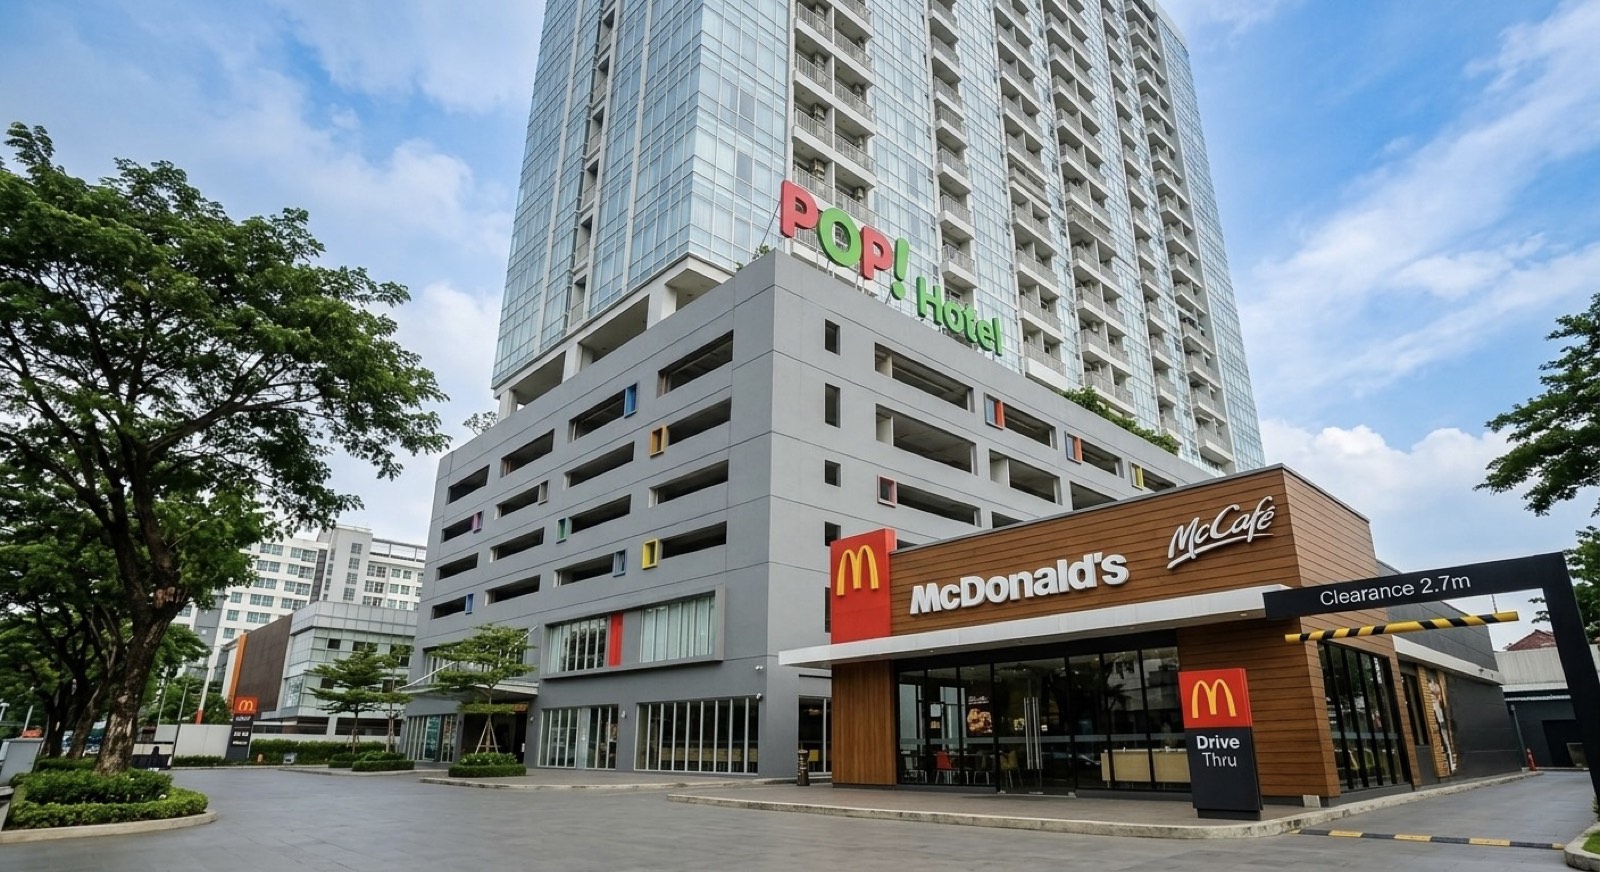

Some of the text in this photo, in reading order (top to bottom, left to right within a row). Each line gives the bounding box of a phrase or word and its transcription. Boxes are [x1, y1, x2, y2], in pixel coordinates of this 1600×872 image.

[780, 180, 1003, 356] POP! Hotel
[1167, 495, 1276, 562] McCafé
[909, 552, 1130, 615] McDonald's
[1320, 575, 1471, 606] Clearance 2.7m
[1196, 735, 1241, 750] Drive
[1202, 752, 1237, 768] Thru
